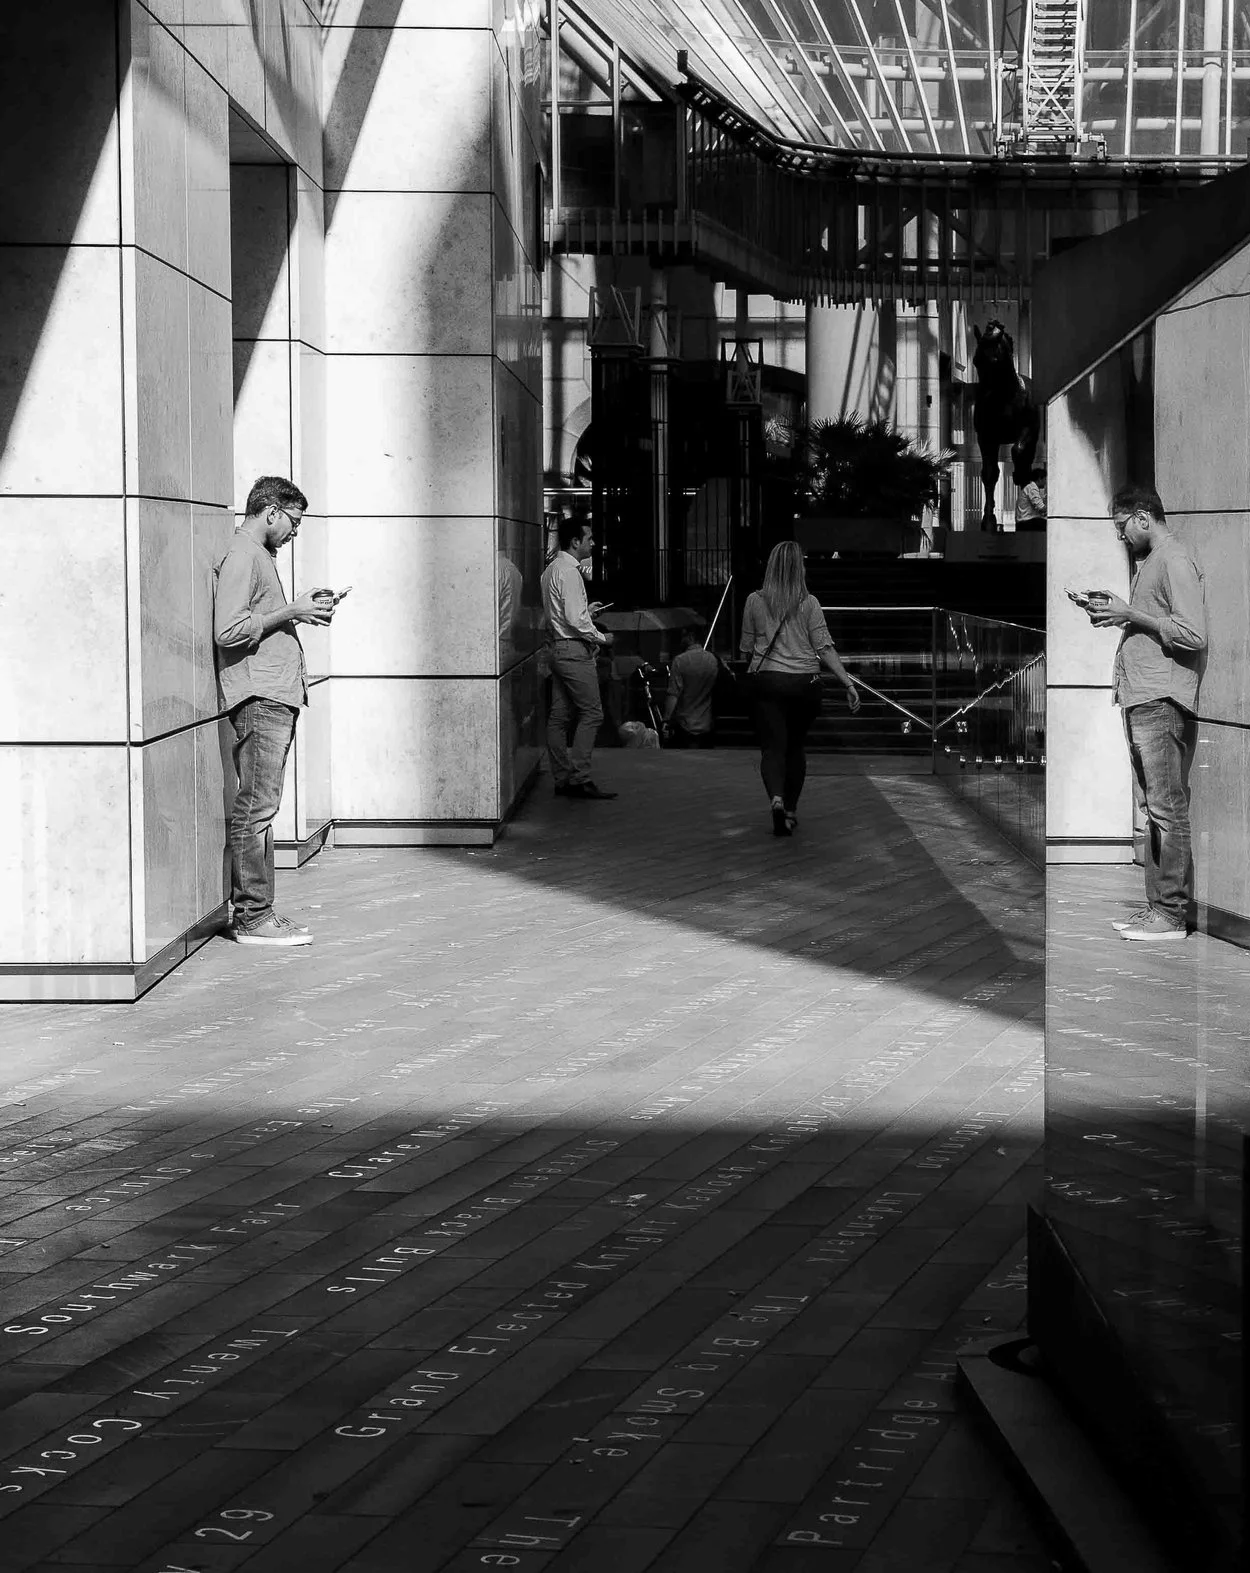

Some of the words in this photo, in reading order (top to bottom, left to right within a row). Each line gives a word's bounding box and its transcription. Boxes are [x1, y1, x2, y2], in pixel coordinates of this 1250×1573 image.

[123, 1053, 297, 1111] Knightrider
[295, 1020, 387, 1046] Street
[298, 1097, 362, 1113] The
[630, 1097, 693, 1120] Arms
[190, 1121, 302, 1159] Earl's
[508, 1139, 620, 1189] Sixteen
[64, 1168, 192, 1211] Sluice
[3, 1244, 218, 1335] Southwark
[210, 1202, 302, 1233] Fair
[328, 1143, 421, 1179] Clare
[410, 1101, 511, 1137] Market
[424, 1196, 521, 1238] Black
[326, 1246, 437, 1293] Bulls
[194, 1508, 275, 1541] 29
[333, 1370, 461, 1438] Grand
[448, 1280, 590, 1355] Elected
[572, 1219, 679, 1270] Knight
[746, 1114, 829, 1151] Knight
[738, 1295, 812, 1324] The
[133, 1328, 302, 1400] Twenty
[674, 1337, 761, 1372] Big
[785, 1398, 941, 1548] Partridge
[480, 1516, 583, 1565] The
